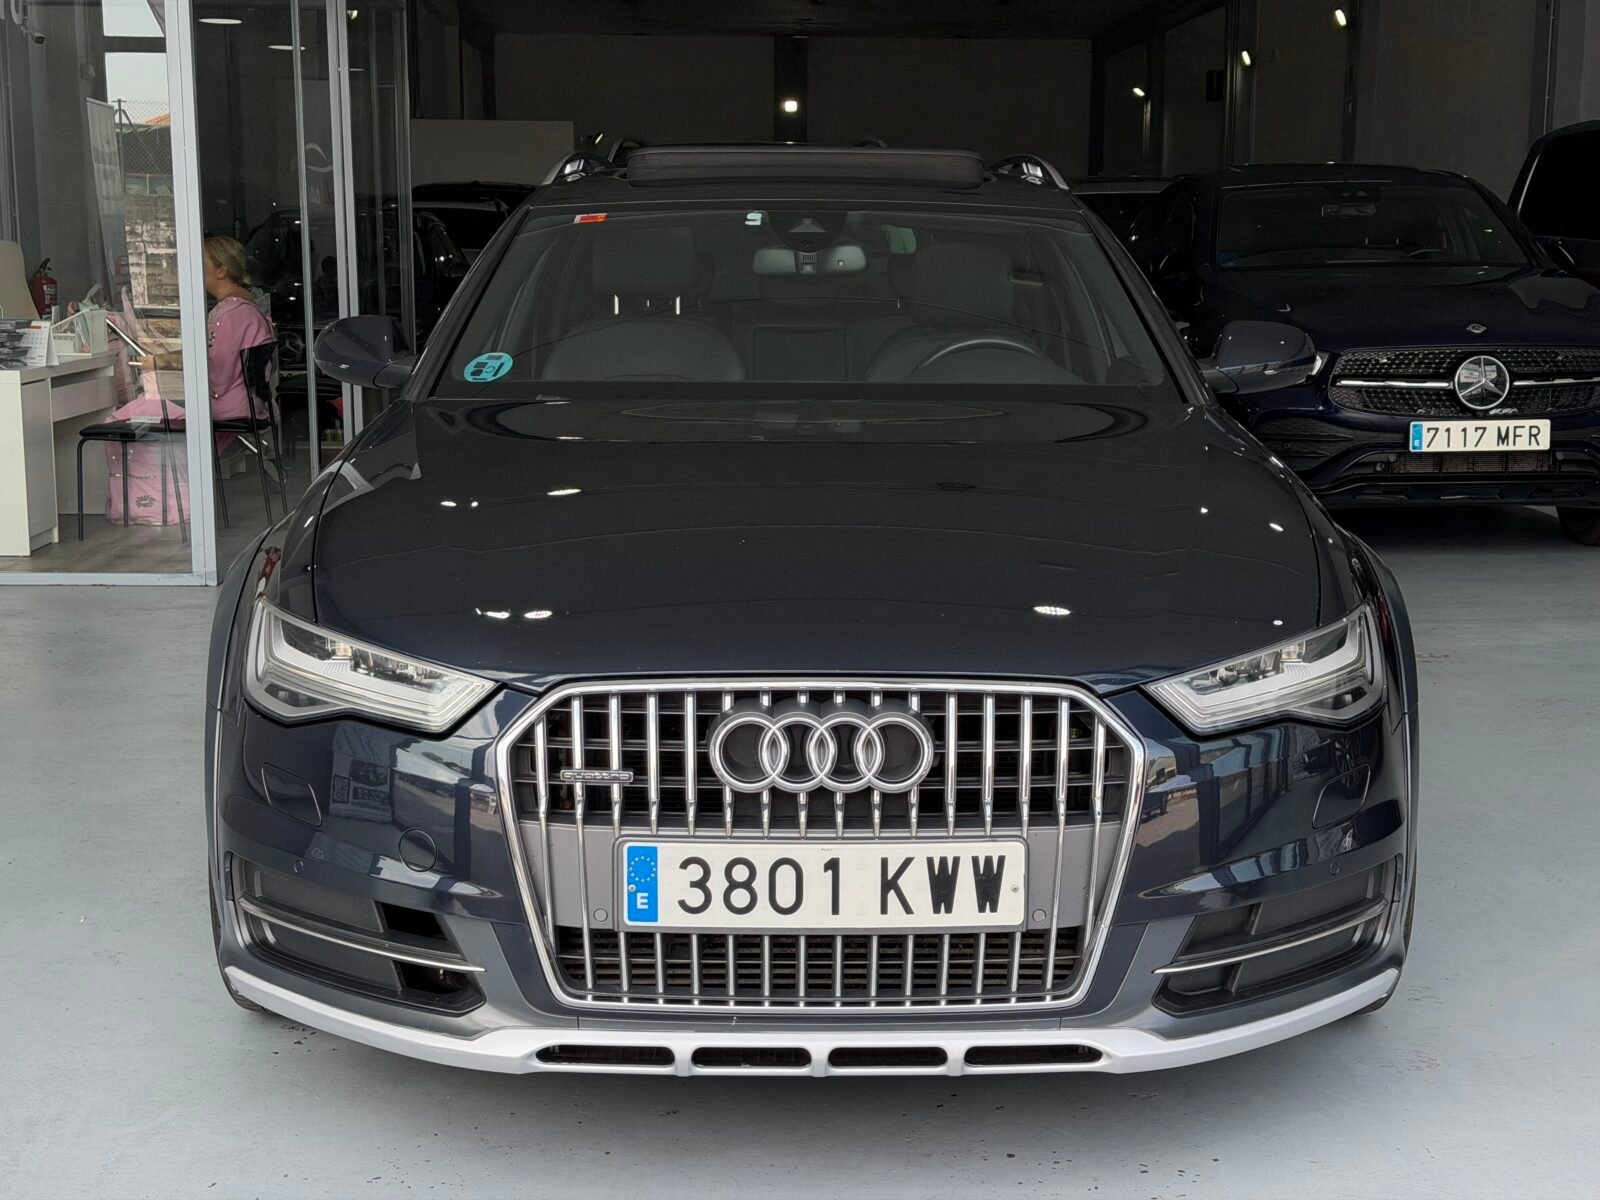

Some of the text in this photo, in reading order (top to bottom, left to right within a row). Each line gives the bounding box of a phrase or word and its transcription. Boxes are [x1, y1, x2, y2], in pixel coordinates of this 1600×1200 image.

[1427, 426, 1541, 448] 7117 MFR
[677, 855, 1006, 916] 3801 KWW
[636, 892, 649, 909] E
